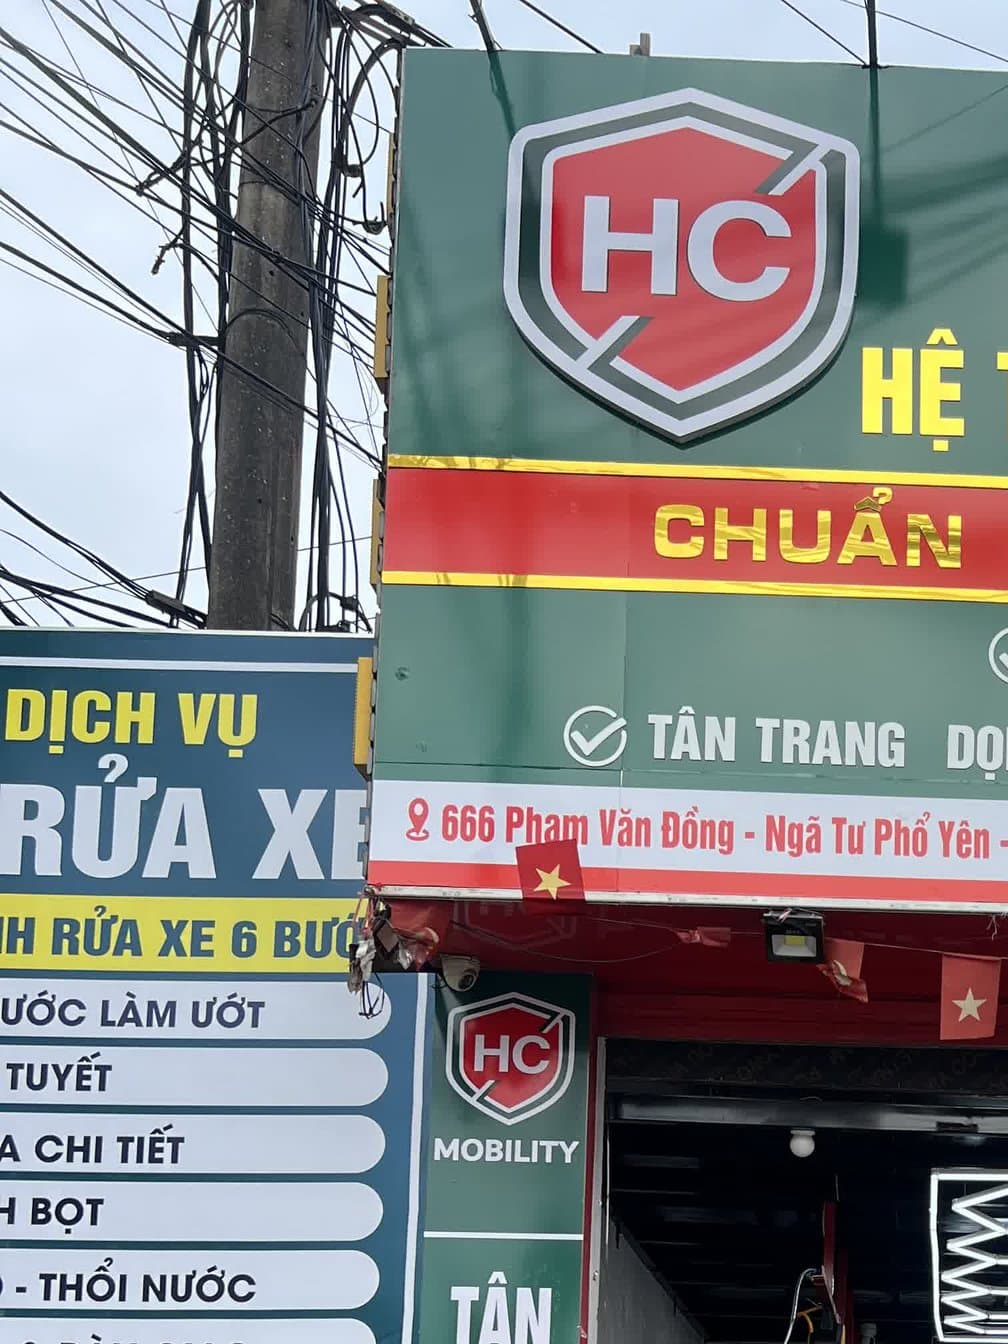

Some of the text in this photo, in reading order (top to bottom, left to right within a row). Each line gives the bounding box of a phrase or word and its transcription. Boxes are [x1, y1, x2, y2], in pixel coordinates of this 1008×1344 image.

[581, 195, 791, 302] HC
[861, 327, 964, 451] HỆ
[654, 487, 961, 568] CHUẨN
[5, 688, 258, 758] DỊCH VỤ
[648, 707, 736, 763] TÂN
[755, 716, 906, 769] TRANG
[0, 753, 367, 881] RỬA XE
[441, 804, 496, 842] 666
[599, 808, 651, 849] Văn
[661, 805, 735, 856] Đồng
[764, 815, 822, 858] Ngã
[831, 819, 867, 856] Tư
[874, 811, 929, 858] Phổ
[938, 817, 990, 860] Yên
[51, 905, 143, 957] RỬA
[158, 919, 216, 958] XE
[231, 919, 257, 959] 6
[100, 991, 177, 1028] LÀM
[191, 992, 266, 1029] ƯỚT
[6, 1051, 113, 1092] TUYẾT
[474, 1034, 551, 1075] HC
[35, 1135, 104, 1163] CHI
[117, 1124, 185, 1164] TIẾT
[433, 1137, 579, 1163] MOBILITY
[31, 1198, 104, 1235] BỌT
[39, 1257, 127, 1302] THỔI
[142, 1265, 257, 1303] NƯỚC
